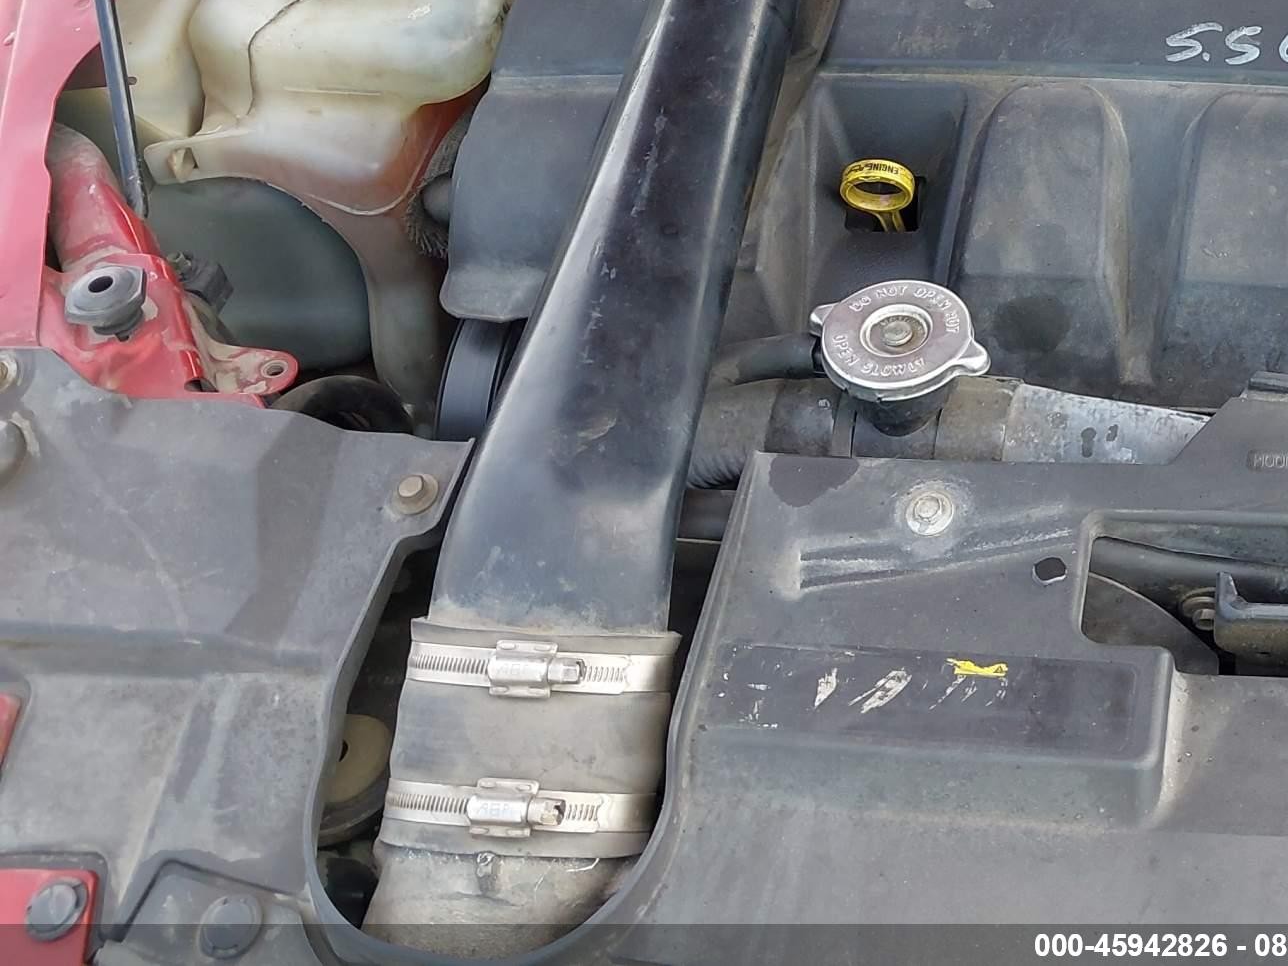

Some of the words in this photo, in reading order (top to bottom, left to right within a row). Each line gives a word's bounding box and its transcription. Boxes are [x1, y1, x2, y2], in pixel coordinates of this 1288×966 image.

[865, 162, 899, 175] ENGINE
[849, 296, 872, 312] DO
[875, 285, 908, 298] NOT
[912, 288, 952, 311] OPEN
[832, 334, 860, 366] OPEN
[860, 357, 926, 377] SLOWLY
